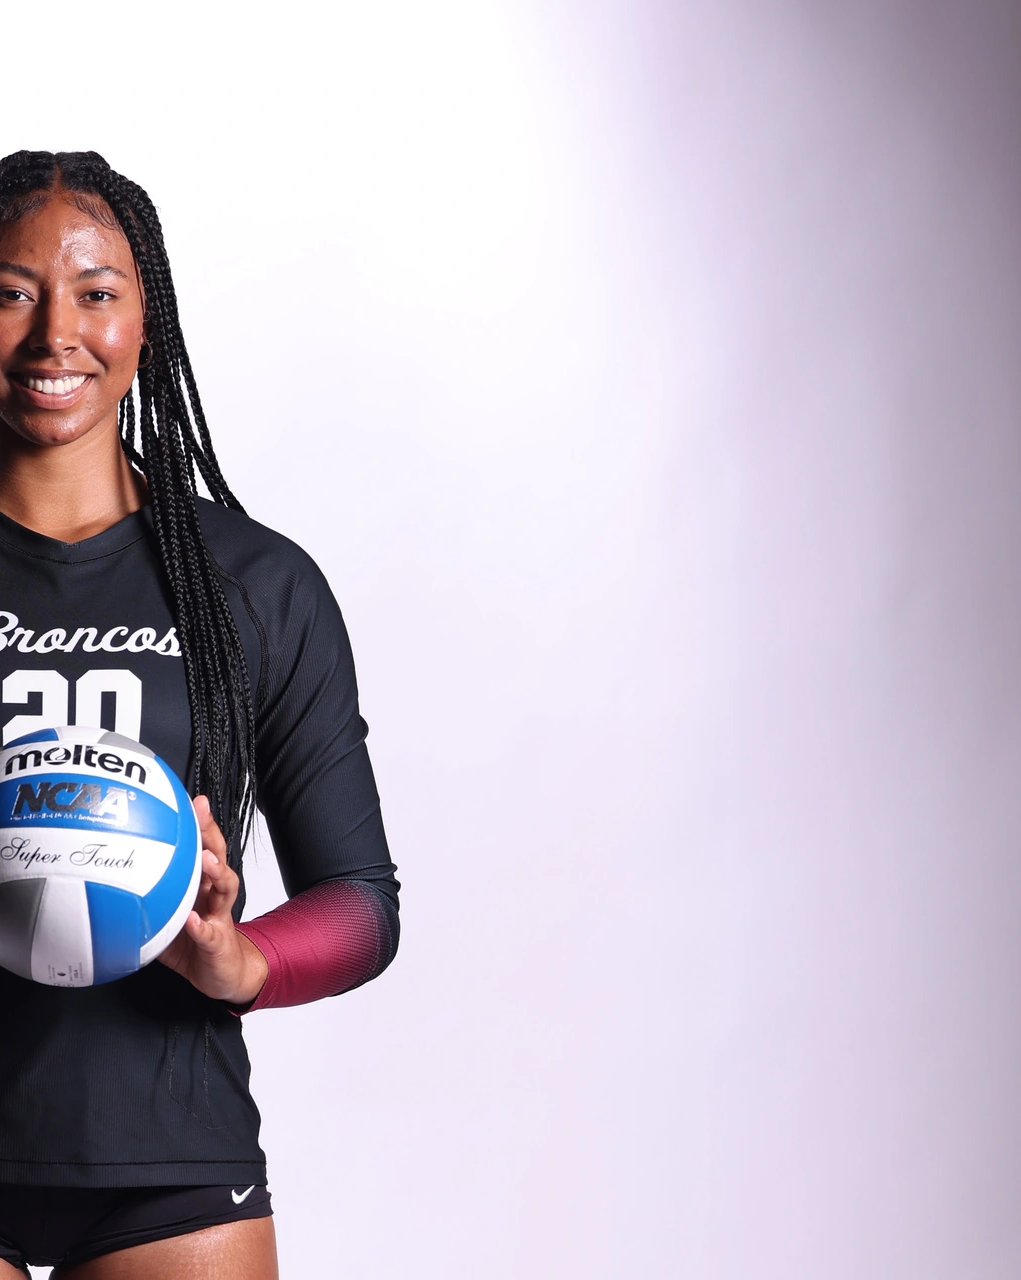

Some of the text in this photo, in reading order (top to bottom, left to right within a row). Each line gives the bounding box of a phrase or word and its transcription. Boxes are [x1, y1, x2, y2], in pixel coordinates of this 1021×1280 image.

[4, 744, 147, 785] molten
[11, 781, 130, 823] NCAA
[0, 836, 135, 870] Super Touch
